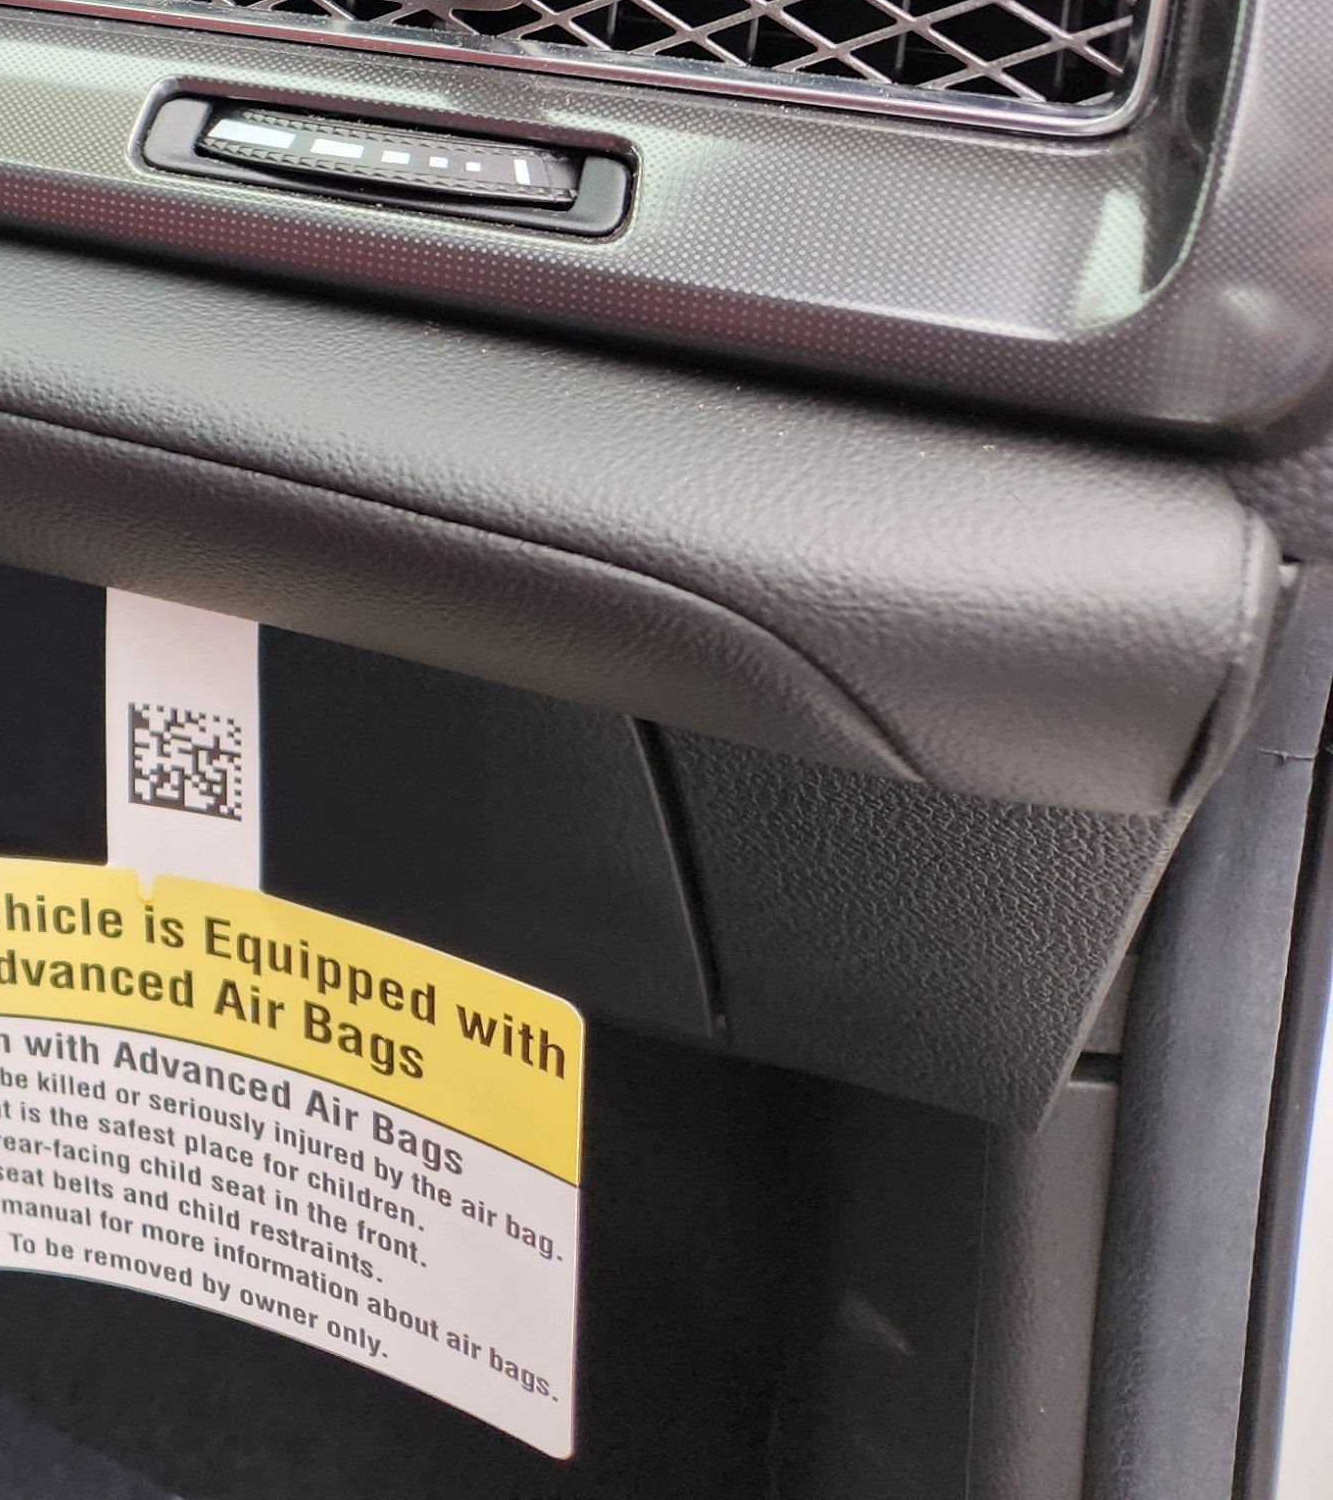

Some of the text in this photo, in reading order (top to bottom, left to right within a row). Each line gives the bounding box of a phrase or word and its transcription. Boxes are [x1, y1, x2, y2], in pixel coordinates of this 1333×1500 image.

[144, 904, 185, 949] is
[204, 915, 436, 1026] Equipped
[455, 1003, 565, 1081] with
[213, 978, 286, 1031] Air
[303, 999, 424, 1080] Bags
[0, 1066, 28, 1090] be
[37, 1071, 106, 1101] killed
[115, 1087, 141, 1107] or
[148, 1093, 266, 1141] seriously
[274, 1120, 365, 1172] injured
[374, 1155, 404, 1190] by
[411, 1172, 452, 1208] the
[461, 1198, 498, 1228] air
[505, 1212, 563, 1262] bag.
[20, 1101, 41, 1124] is
[49, 1106, 89, 1131] the
[97, 1117, 175, 1148] safest
[184, 1134, 254, 1168] place
[263, 1152, 300, 1182] for
[307, 1171, 425, 1232] children.
[23, 1032, 100, 1066] with
[113, 1041, 291, 1111] Advanced
[304, 1089, 359, 1132] Air
[372, 1110, 463, 1176] Bags
[52, 1170, 114, 1200] belts
[123, 1187, 169, 1212] and
[178, 1198, 240, 1231] child
[250, 1219, 383, 1284] restraints.
[139, 1156, 202, 1187] child
[210, 1174, 266, 1206] seat
[275, 1188, 298, 1217] in
[306, 1201, 348, 1234] the
[356, 1219, 427, 1269] front.
[1, 1198, 92, 1227] manual
[99, 1210, 134, 1235] for
[141, 1222, 205, 1253] more
[214, 1236, 359, 1307] information
[367, 1296, 439, 1342] about
[446, 1331, 482, 1360] air
[489, 1346, 558, 1403] bags.
[8, 1232, 388, 1359] To be removed by owner only.
